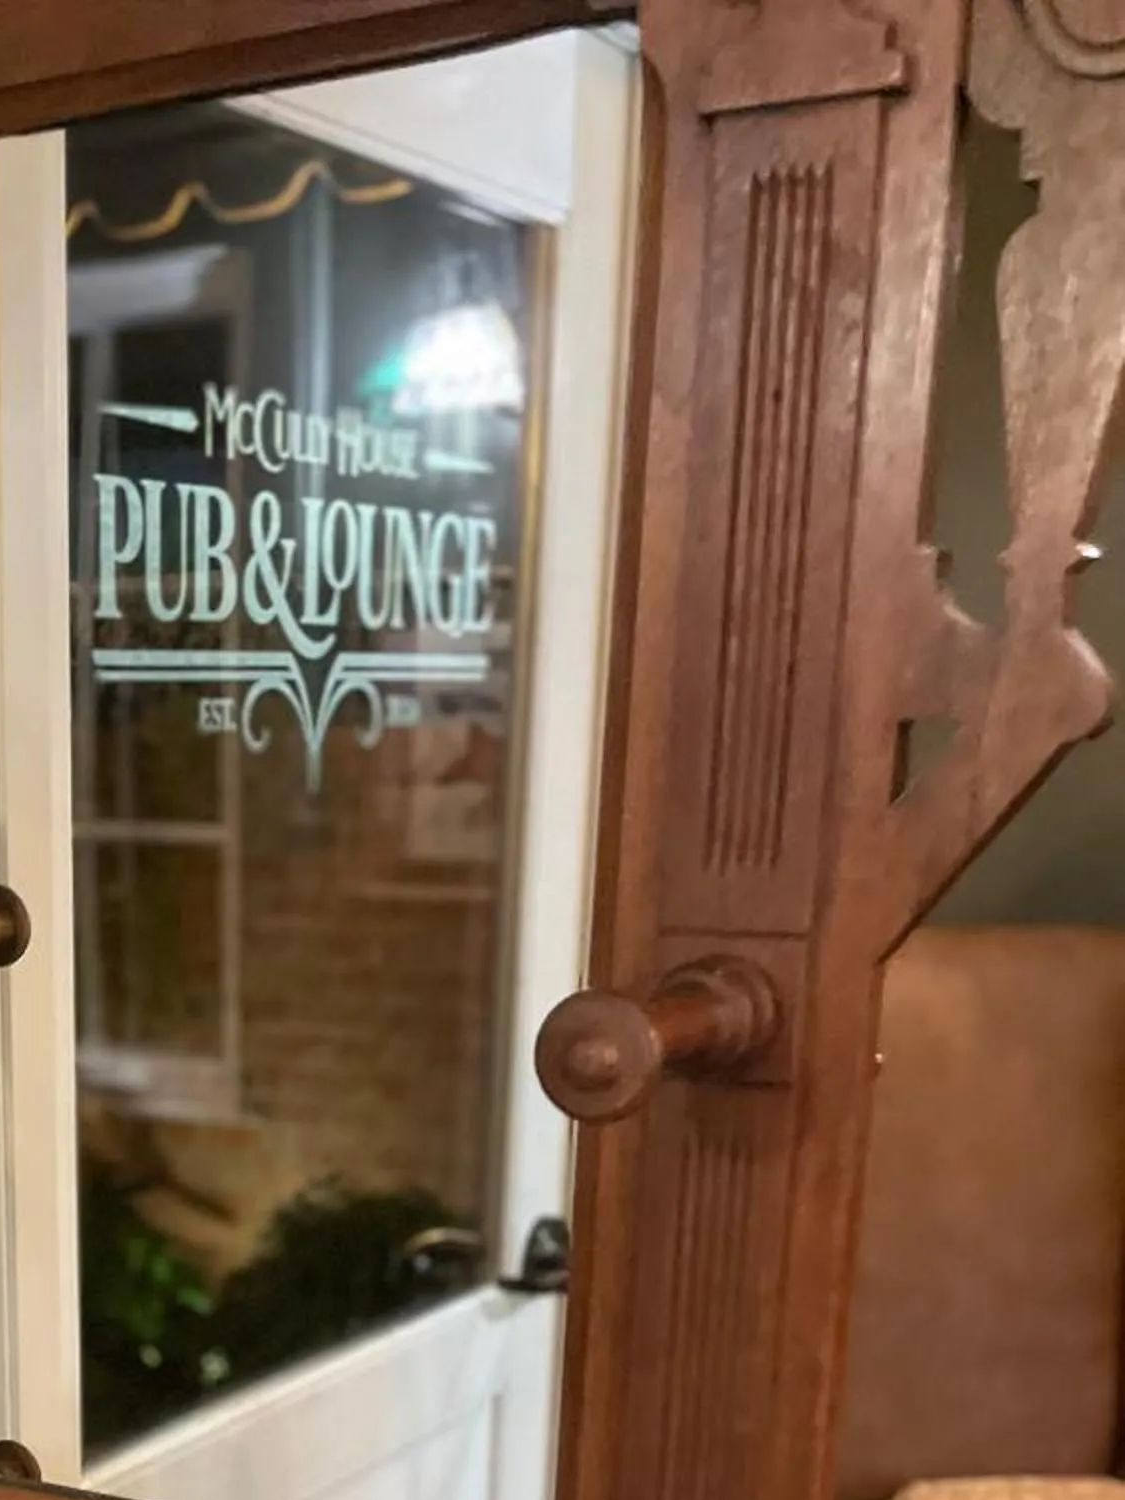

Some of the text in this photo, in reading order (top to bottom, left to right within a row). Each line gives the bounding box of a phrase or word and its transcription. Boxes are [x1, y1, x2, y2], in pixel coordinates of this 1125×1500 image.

[94, 474, 495, 659] PUB & LOUNGE
